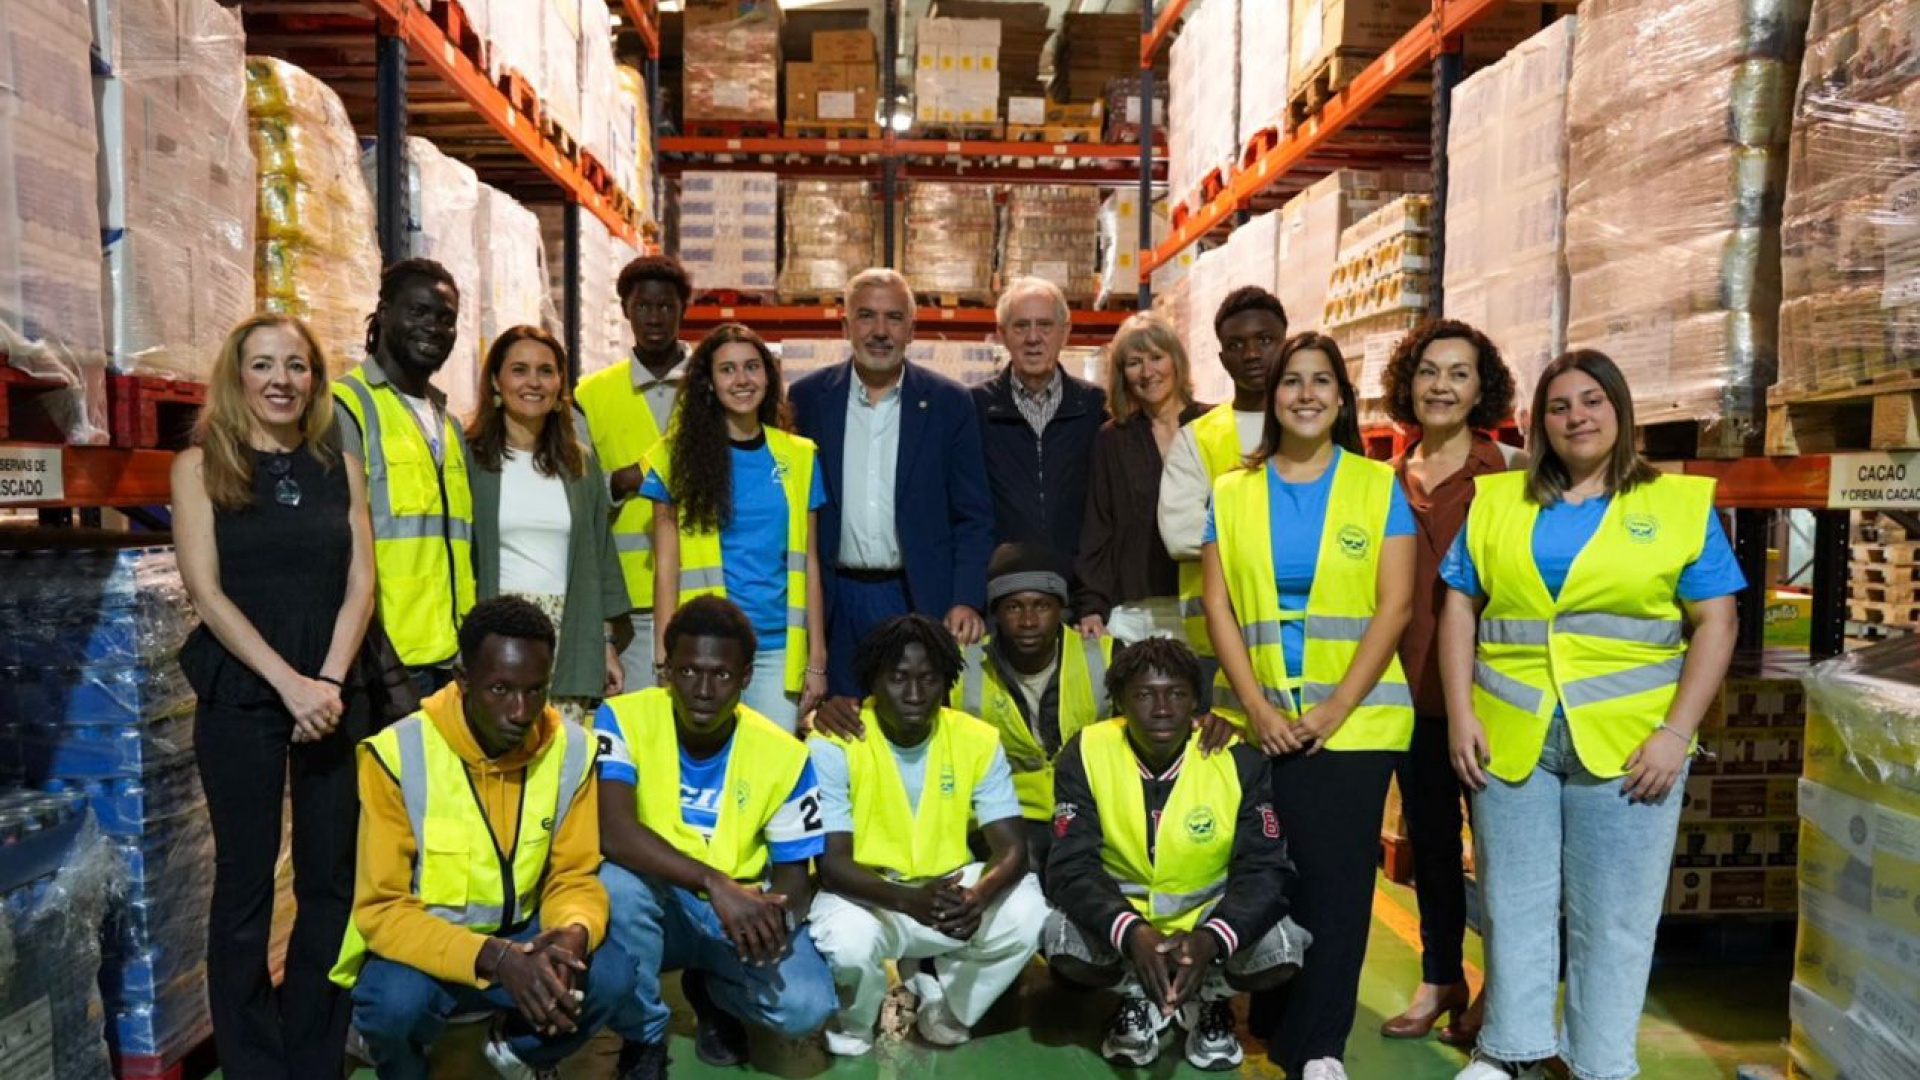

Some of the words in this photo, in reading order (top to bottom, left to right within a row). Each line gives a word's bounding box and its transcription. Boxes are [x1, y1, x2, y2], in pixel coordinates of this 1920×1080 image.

[35, 459, 47, 471] DE
[1858, 464, 1906, 481] CACAO
[1841, 489, 1847, 500] Y
[1849, 489, 1883, 500] CREMA
